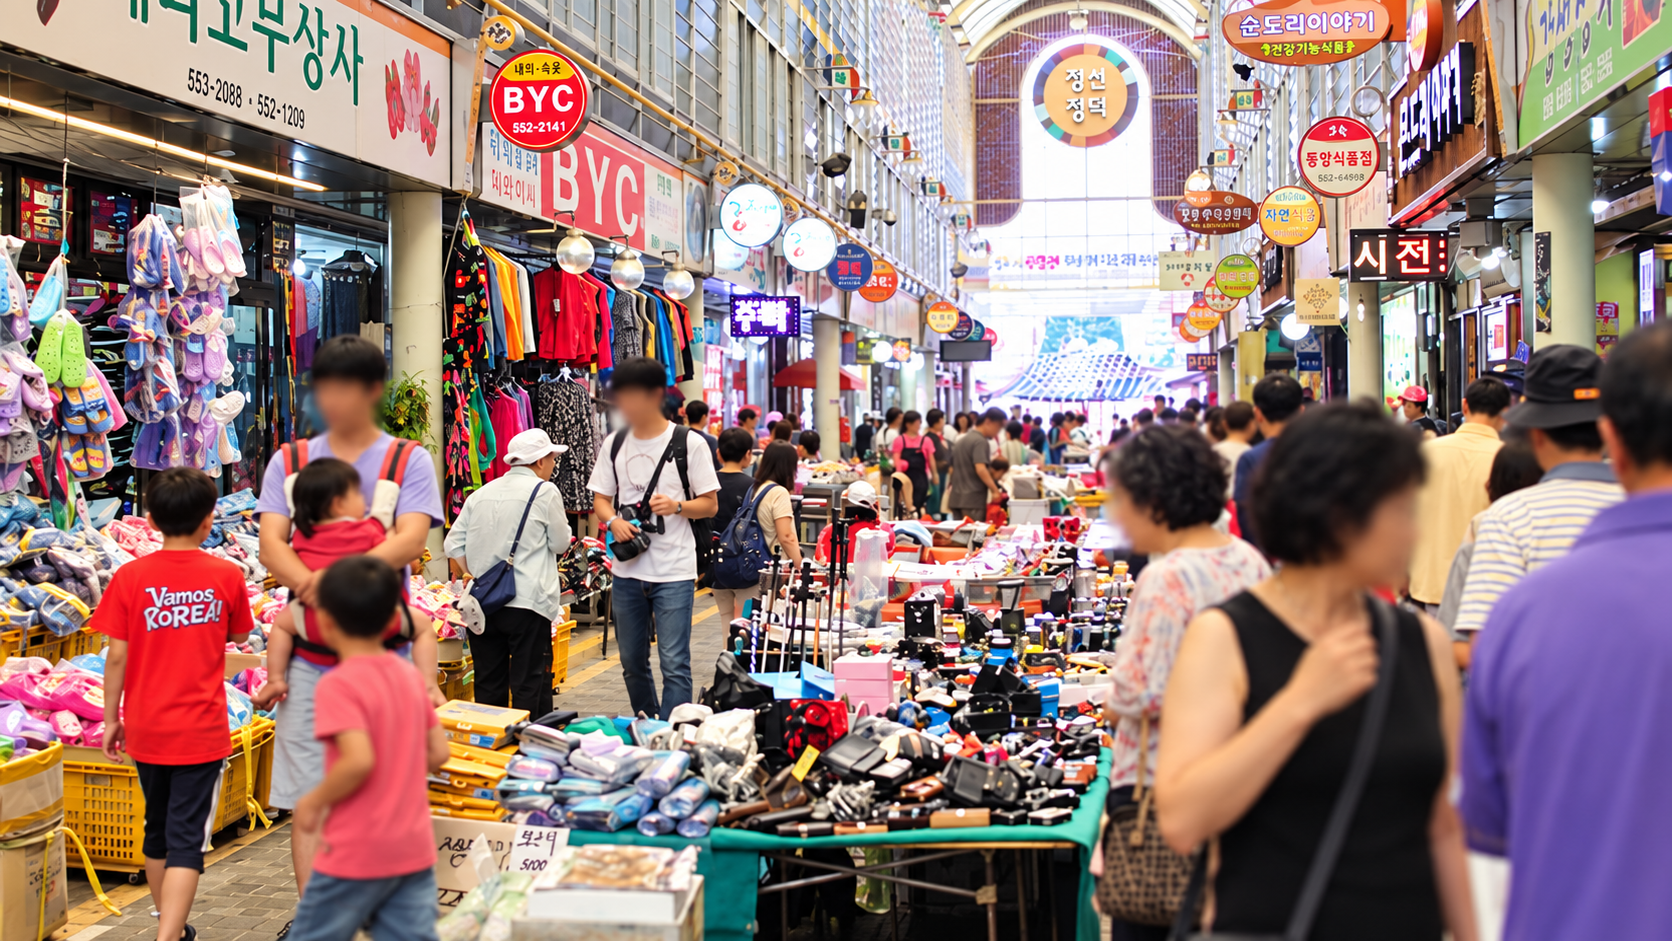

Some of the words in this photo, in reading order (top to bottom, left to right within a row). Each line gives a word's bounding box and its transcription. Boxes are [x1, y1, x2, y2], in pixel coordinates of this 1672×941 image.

[1239, 10, 1375, 38] 순도리이야기
[187, 67, 243, 109] 553-2088
[257, 93, 306, 130] 552-1209
[503, 84, 574, 114] BYC
[512, 121, 566, 134] 552-2141
[552, 143, 639, 238] BYC
[145, 586, 215, 608] Vamos
